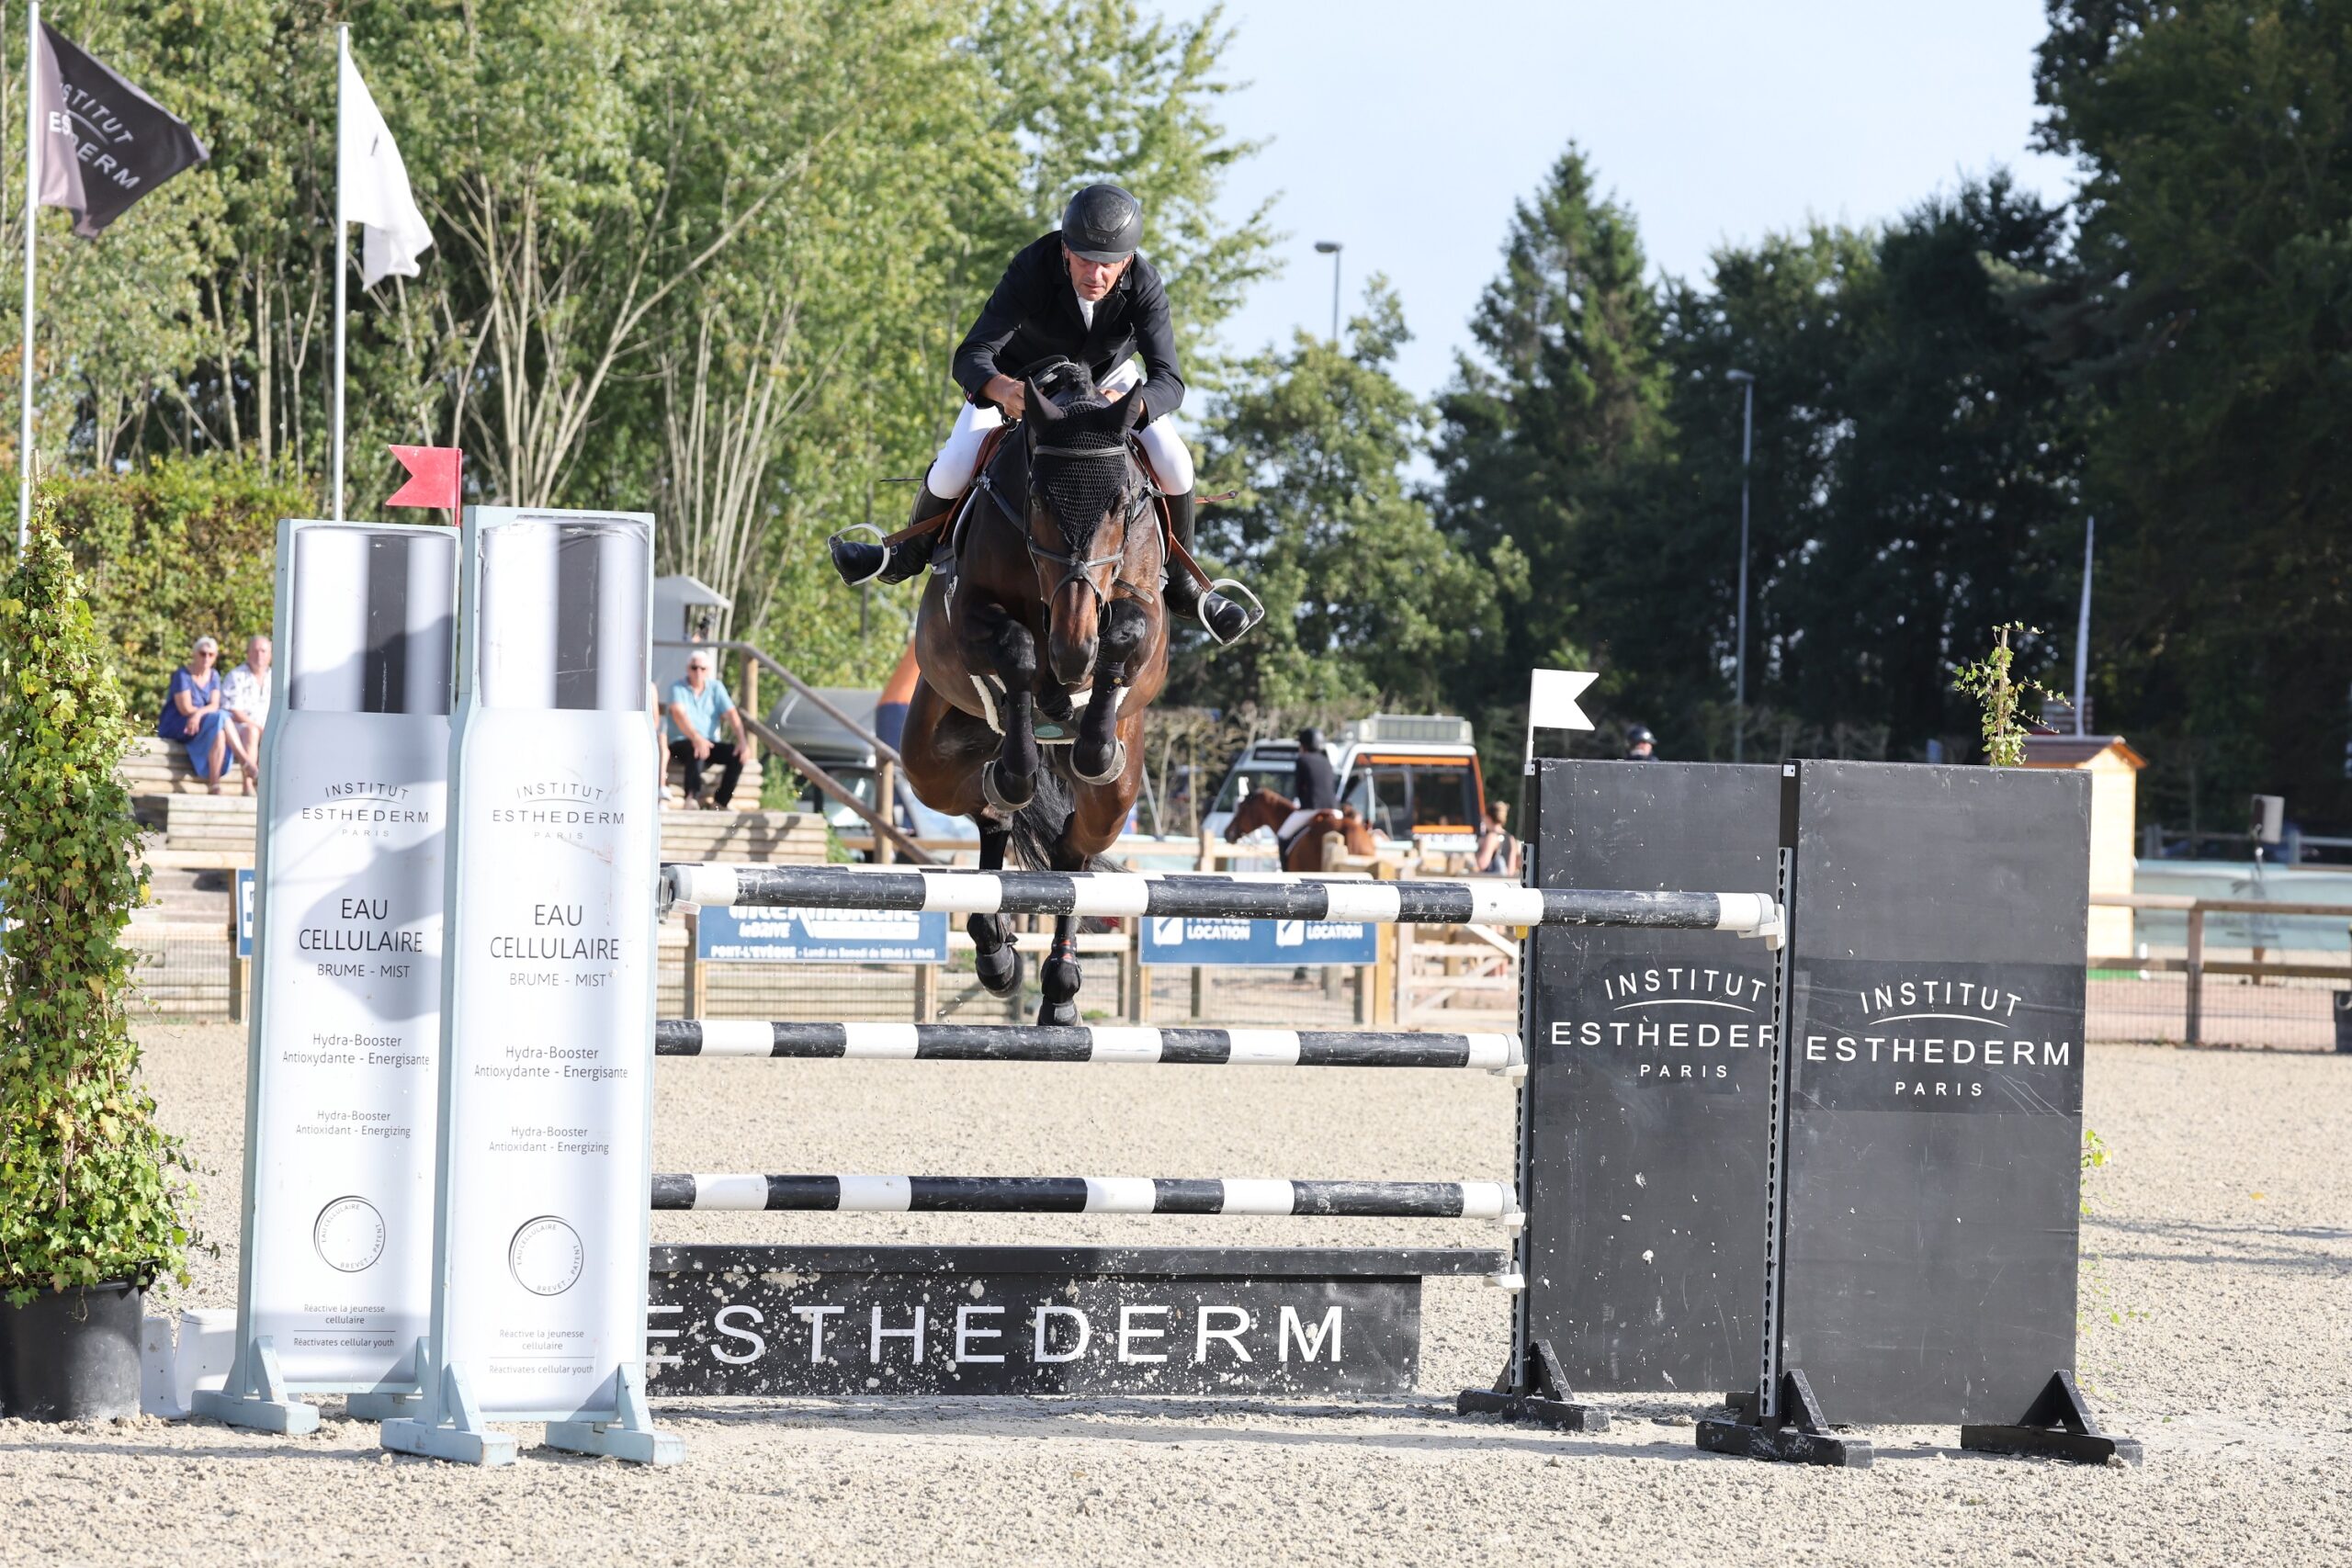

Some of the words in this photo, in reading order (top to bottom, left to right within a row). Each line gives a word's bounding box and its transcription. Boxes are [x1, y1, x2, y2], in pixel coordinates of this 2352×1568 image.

[60, 83, 133, 143] STITUT
[325, 783, 409, 801] INSTITUT
[516, 783, 604, 800] INSTITUT
[302, 808, 429, 823] ESTHEDERM
[492, 809, 625, 825] ESTHEDERM
[342, 829, 390, 837] PARIS
[534, 831, 584, 840] PARIS
[342, 898, 389, 920] EAU
[534, 905, 582, 927] EAU
[1187, 926, 1250, 940] LOCATION
[1306, 926, 1363, 939] LOCATION
[299, 930, 424, 953] CELLULAIRE
[490, 937, 619, 960] CELLULAIRE
[317, 964, 365, 977] BRUME
[380, 964, 410, 978] MIST
[510, 973, 559, 986] BRUME
[576, 973, 605, 987] MIST
[1605, 968, 1767, 1002] INSTITUT
[1861, 981, 2022, 1017] INSTITUT
[313, 1033, 402, 1048] Hydra-Booster
[283, 1051, 355, 1066] Antioxydante
[368, 1052, 430, 1067] Energisante
[505, 1045, 599, 1060] Hydra-Booster
[1806, 1037, 2071, 1066] ESTHEDERM
[474, 1065, 549, 1079] Antioxydante
[564, 1066, 628, 1081] Energisante
[1640, 1065, 1727, 1077] PARIS
[1895, 1082, 1983, 1096] PARIS
[317, 1111, 390, 1122] Hydra-Booster
[296, 1124, 351, 1135] Antioxidant
[361, 1125, 411, 1138] Energizing
[511, 1126, 587, 1138] Hydra-Booster
[489, 1141, 547, 1153] Antioxidant
[558, 1142, 609, 1155] Energizing
[324, 1204, 360, 1226] CELLULAIRE
[520, 1224, 557, 1248] CELLULAIRE
[340, 1258, 368, 1269] BREVET
[373, 1224, 382, 1253] PATENT
[537, 1280, 566, 1292] BREVET
[571, 1245, 580, 1275] PATENT
[340, 1304, 347, 1313] la
[349, 1304, 385, 1314] jeunesse
[325, 1315, 365, 1325] cellulaire
[537, 1329, 545, 1337] la
[547, 1330, 584, 1339] jeunesse
[649, 1304, 1342, 1364] ESTHEDERM
[294, 1337, 338, 1347] Réactivates
[340, 1337, 371, 1347] cellular
[373, 1338, 394, 1348] youth
[522, 1341, 563, 1350] cellulaire
[537, 1365, 570, 1374] cellular
[571, 1365, 594, 1375] youth
